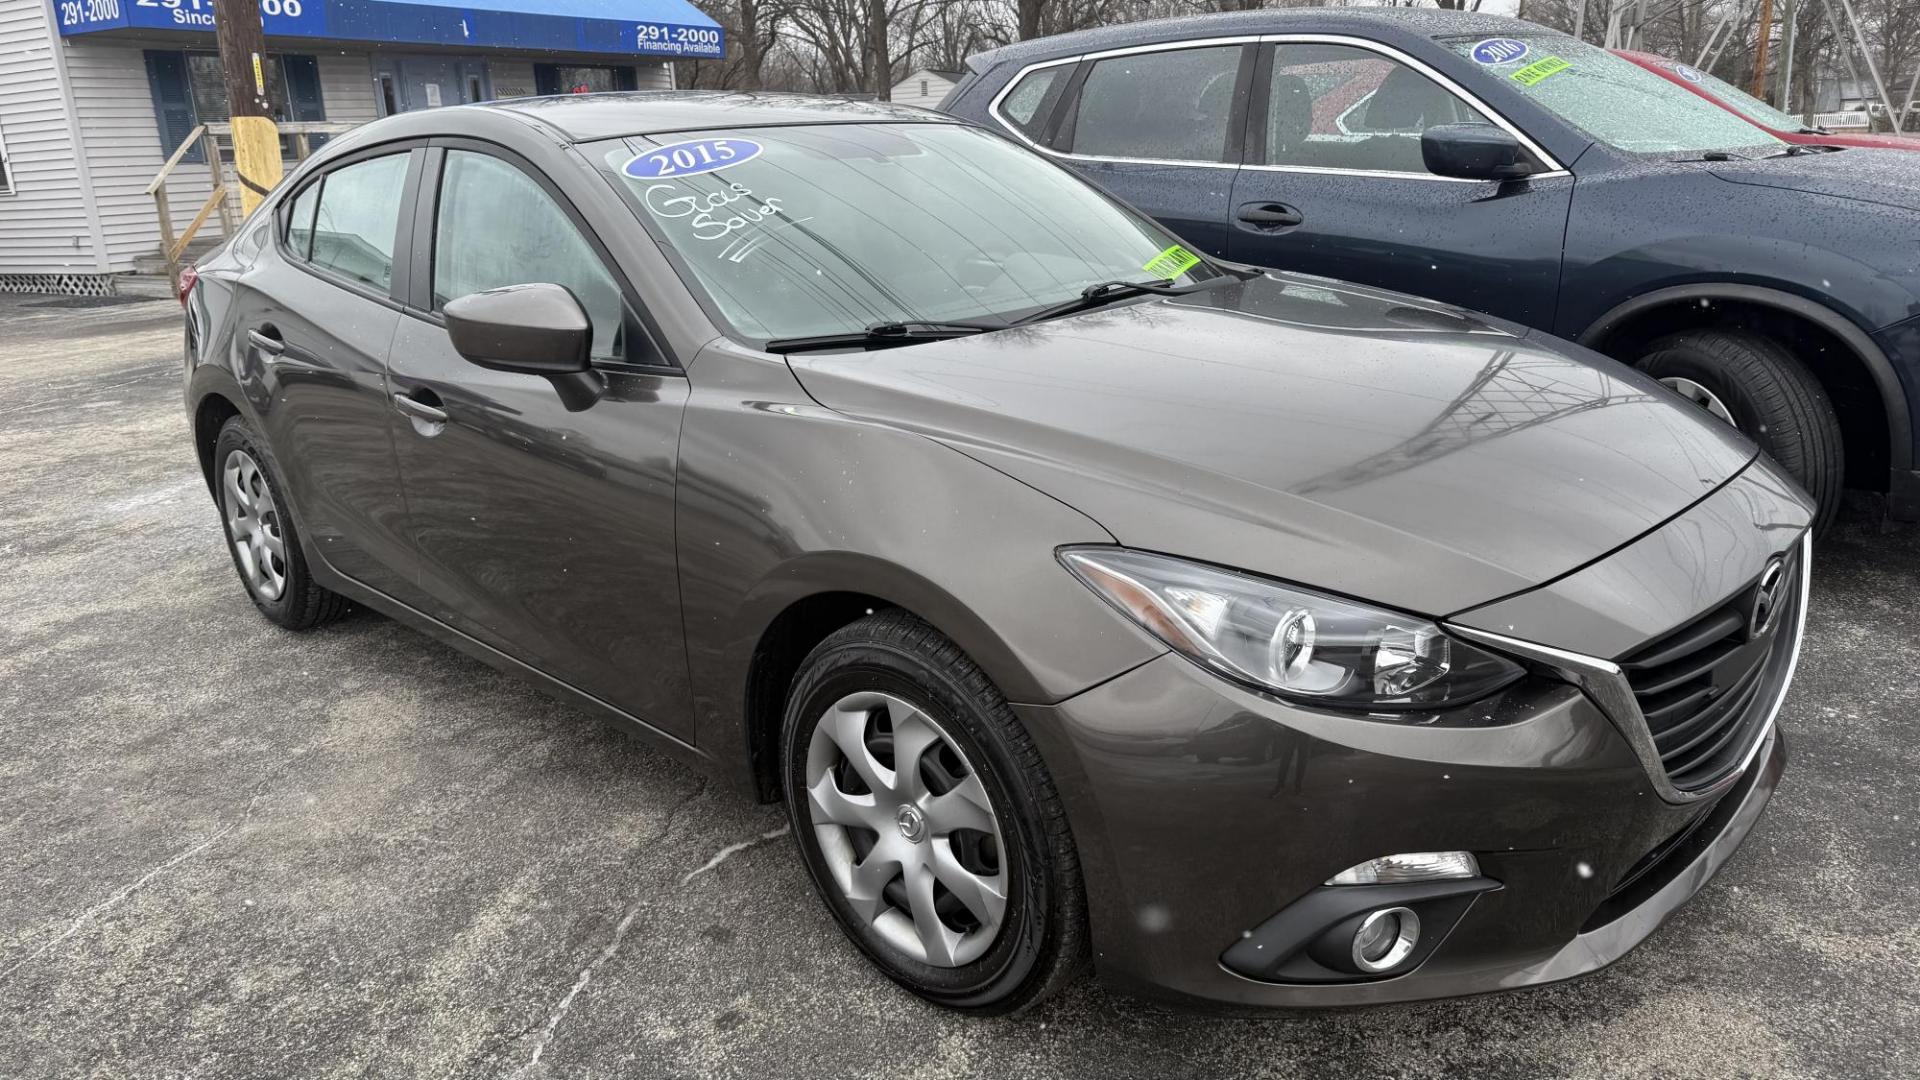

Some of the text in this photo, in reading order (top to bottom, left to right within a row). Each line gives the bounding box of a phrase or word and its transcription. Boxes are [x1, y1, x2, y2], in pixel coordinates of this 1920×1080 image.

[61, 0, 119, 25] 291-2000
[173, 8, 216, 25] Sinc
[636, 25, 719, 43] 291-2000
[637, 38, 721, 54] Financing Available
[1480, 39, 1521, 62] 2016
[1514, 68, 1541, 83] ONE
[649, 140, 737, 176] 2015
[645, 182, 752, 218] Gas
[692, 197, 784, 240] Saver
